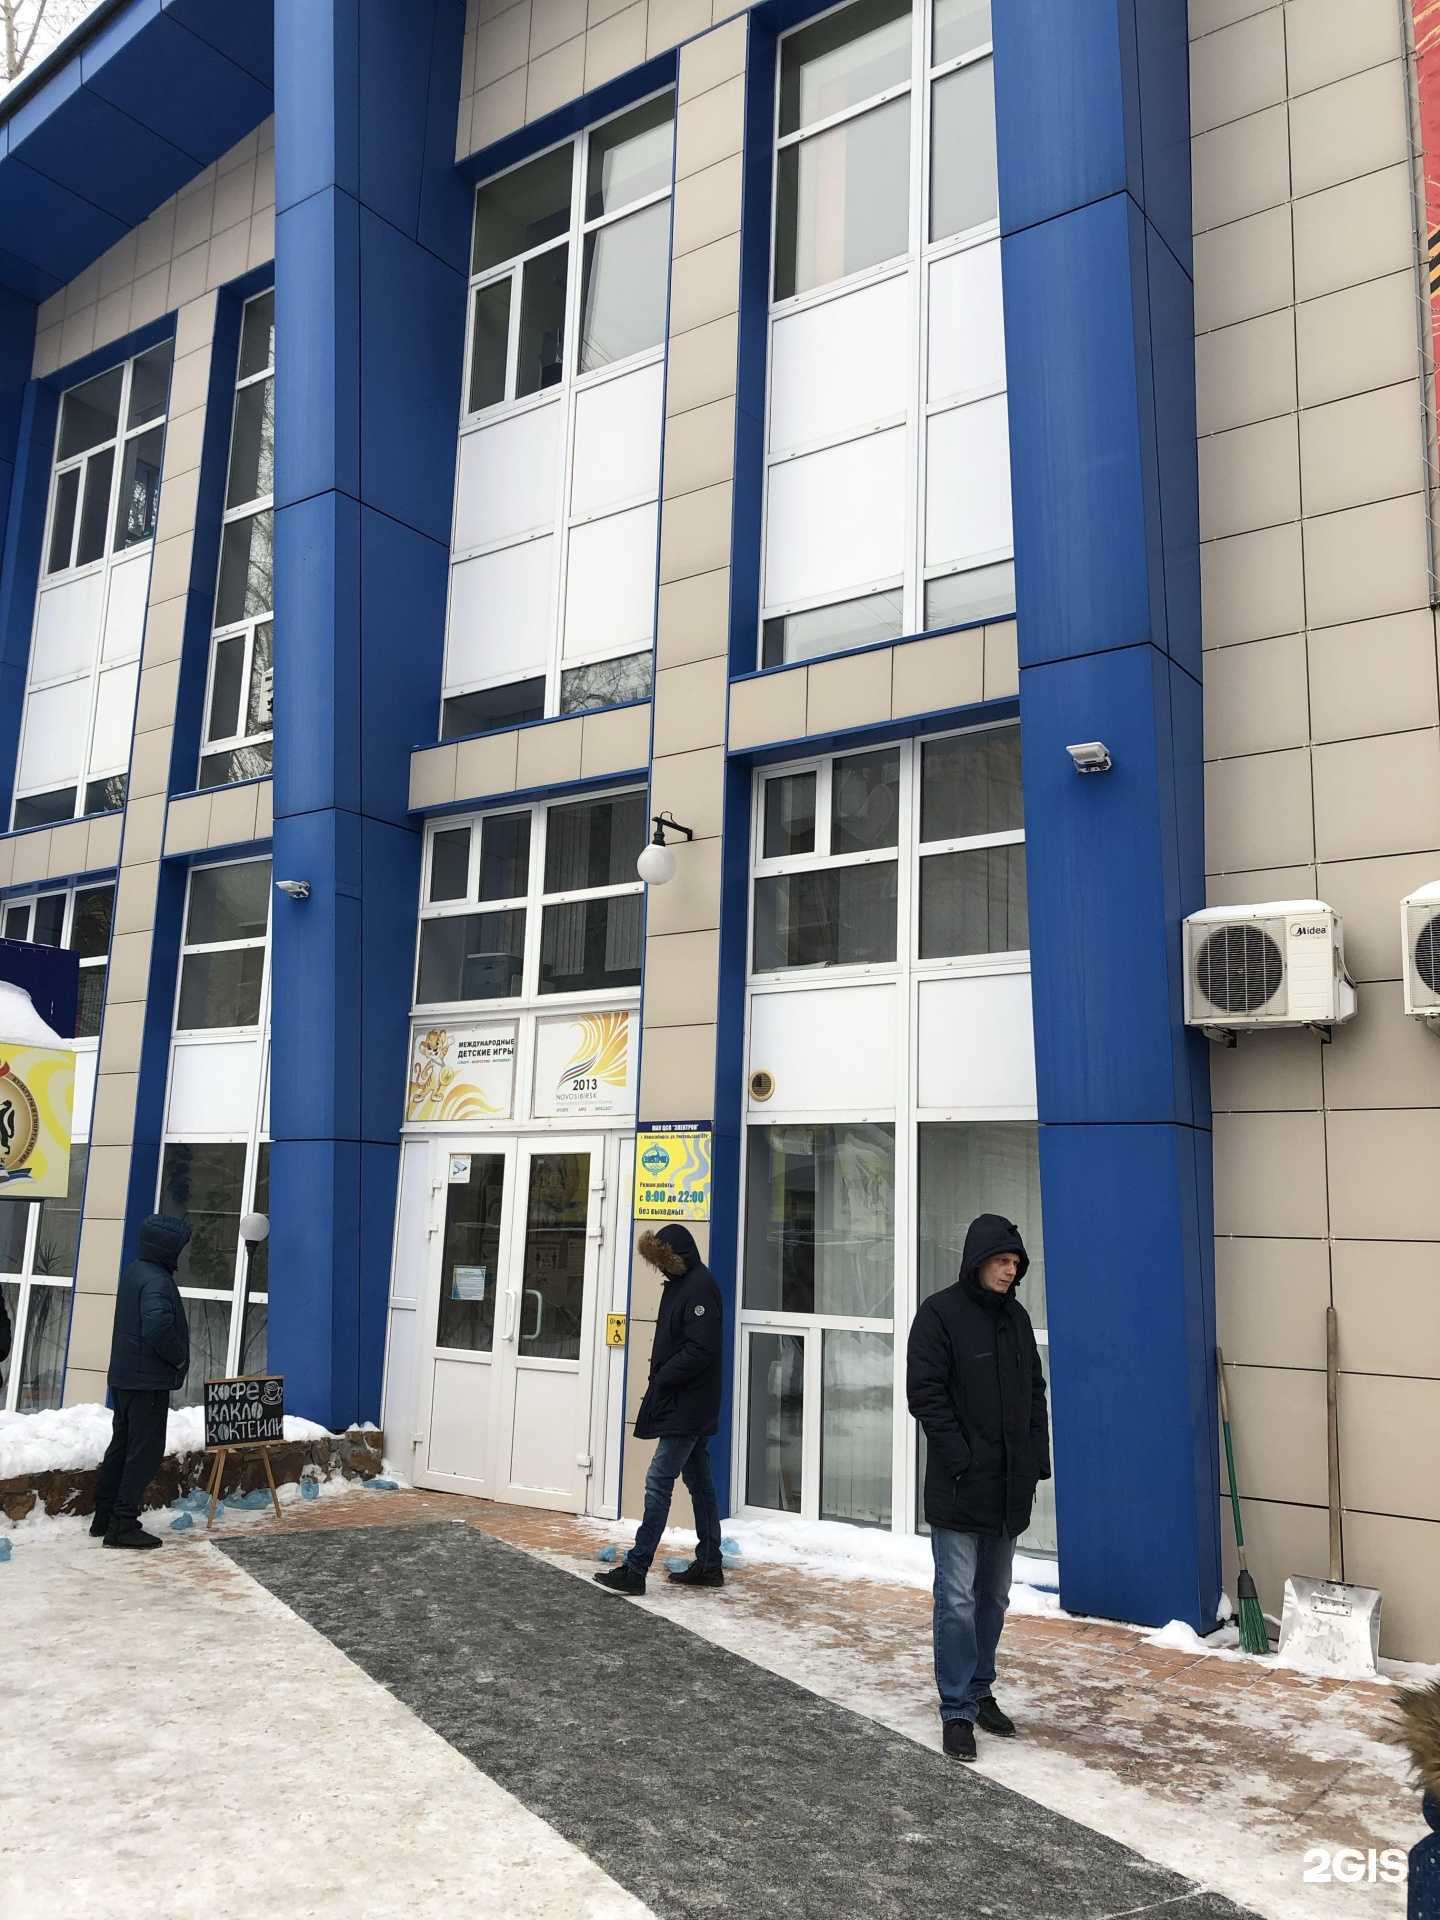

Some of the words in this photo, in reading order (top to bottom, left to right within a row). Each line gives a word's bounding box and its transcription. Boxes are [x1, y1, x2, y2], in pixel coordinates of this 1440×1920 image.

[1296, 926, 1326, 936] Midea
[458, 1038, 515, 1048] МЕЖДУНАРОДНЫЕ
[457, 1049, 491, 1059] ДЕТСКИЕ
[493, 1047, 514, 1056] ИГРЫ
[572, 1079, 598, 1091] 2013
[645, 1191, 666, 1202] 8:00
[667, 1196, 677, 1204] до
[678, 1191, 704, 1203] 22:00
